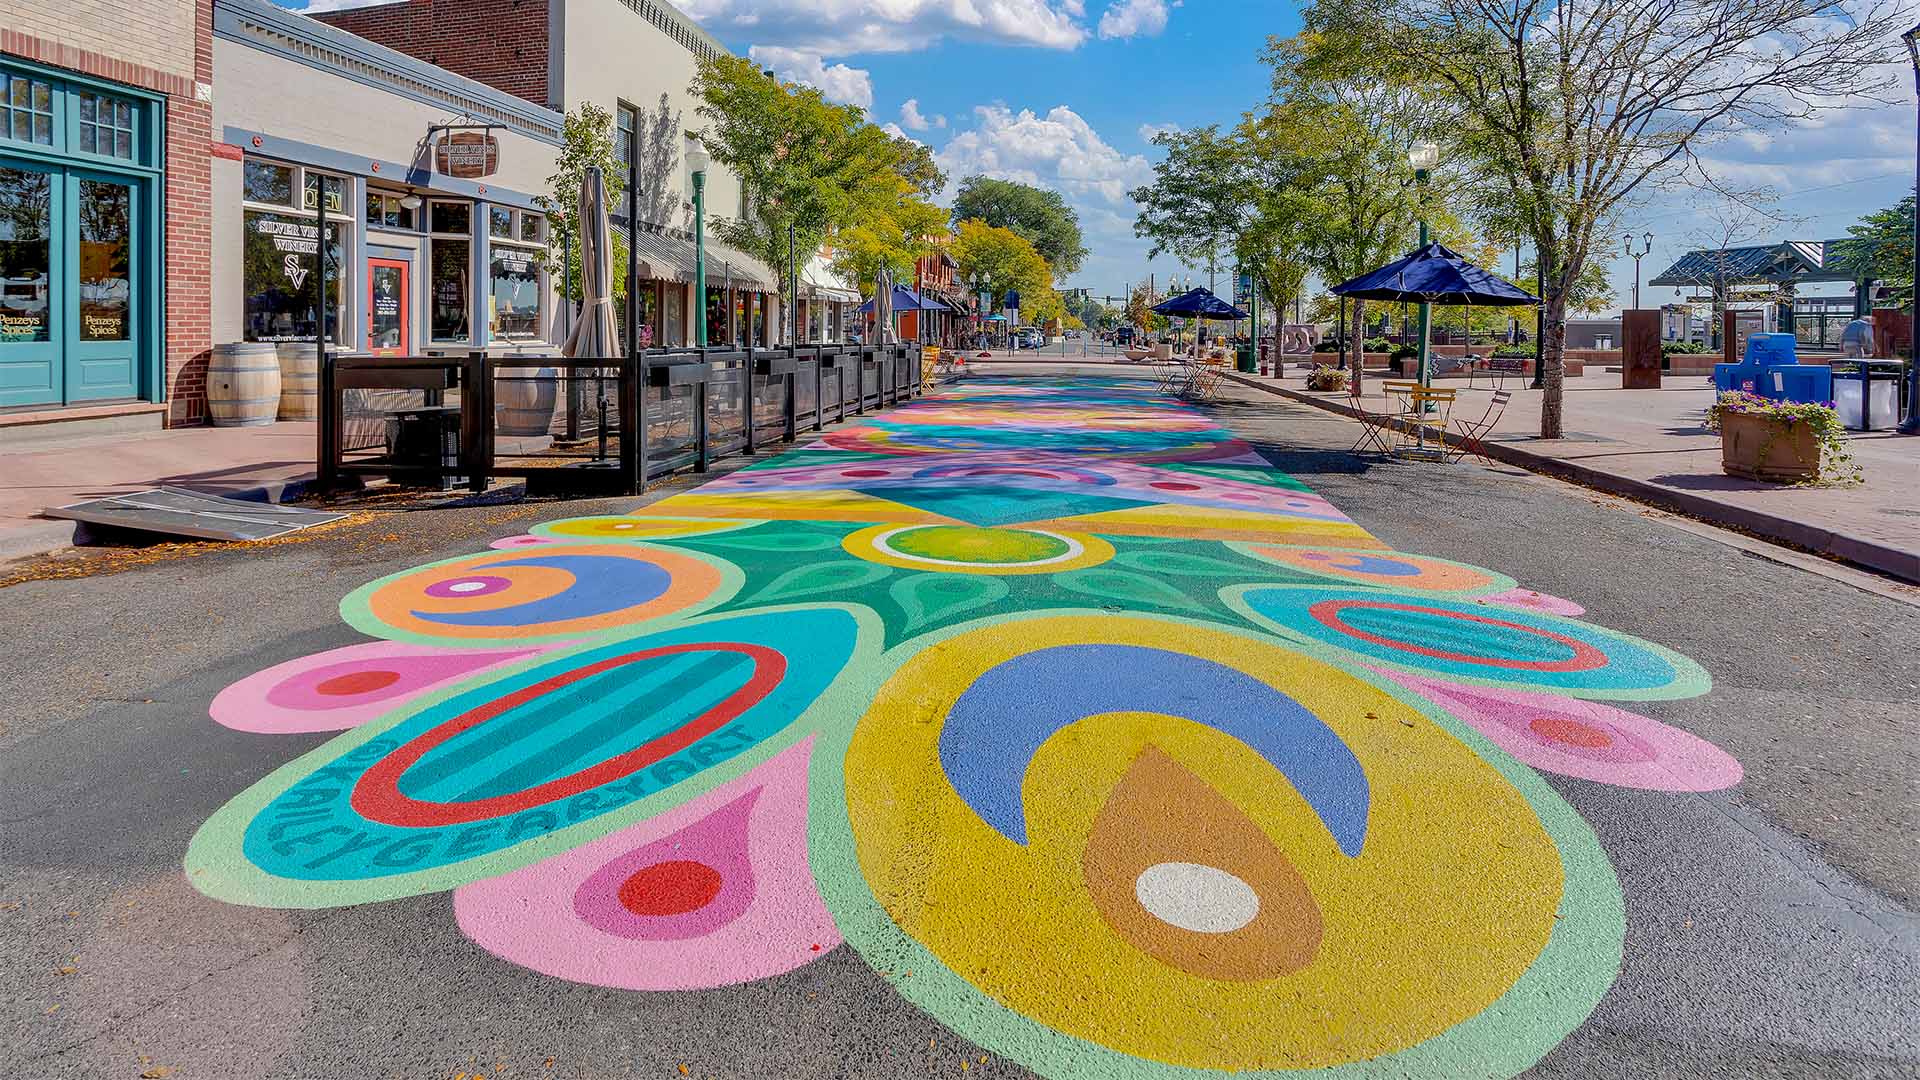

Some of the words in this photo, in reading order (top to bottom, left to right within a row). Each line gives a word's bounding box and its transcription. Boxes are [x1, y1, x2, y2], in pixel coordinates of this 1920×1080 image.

[259, 220, 300, 236] SILVER
[300, 225, 331, 240] VINS
[273, 239, 318, 254] WINERY
[0, 313, 40, 327] Penzeys
[85, 315, 121, 327] Penzeys
[2, 325, 33, 338] Spices
[89, 326, 117, 337] Spices
